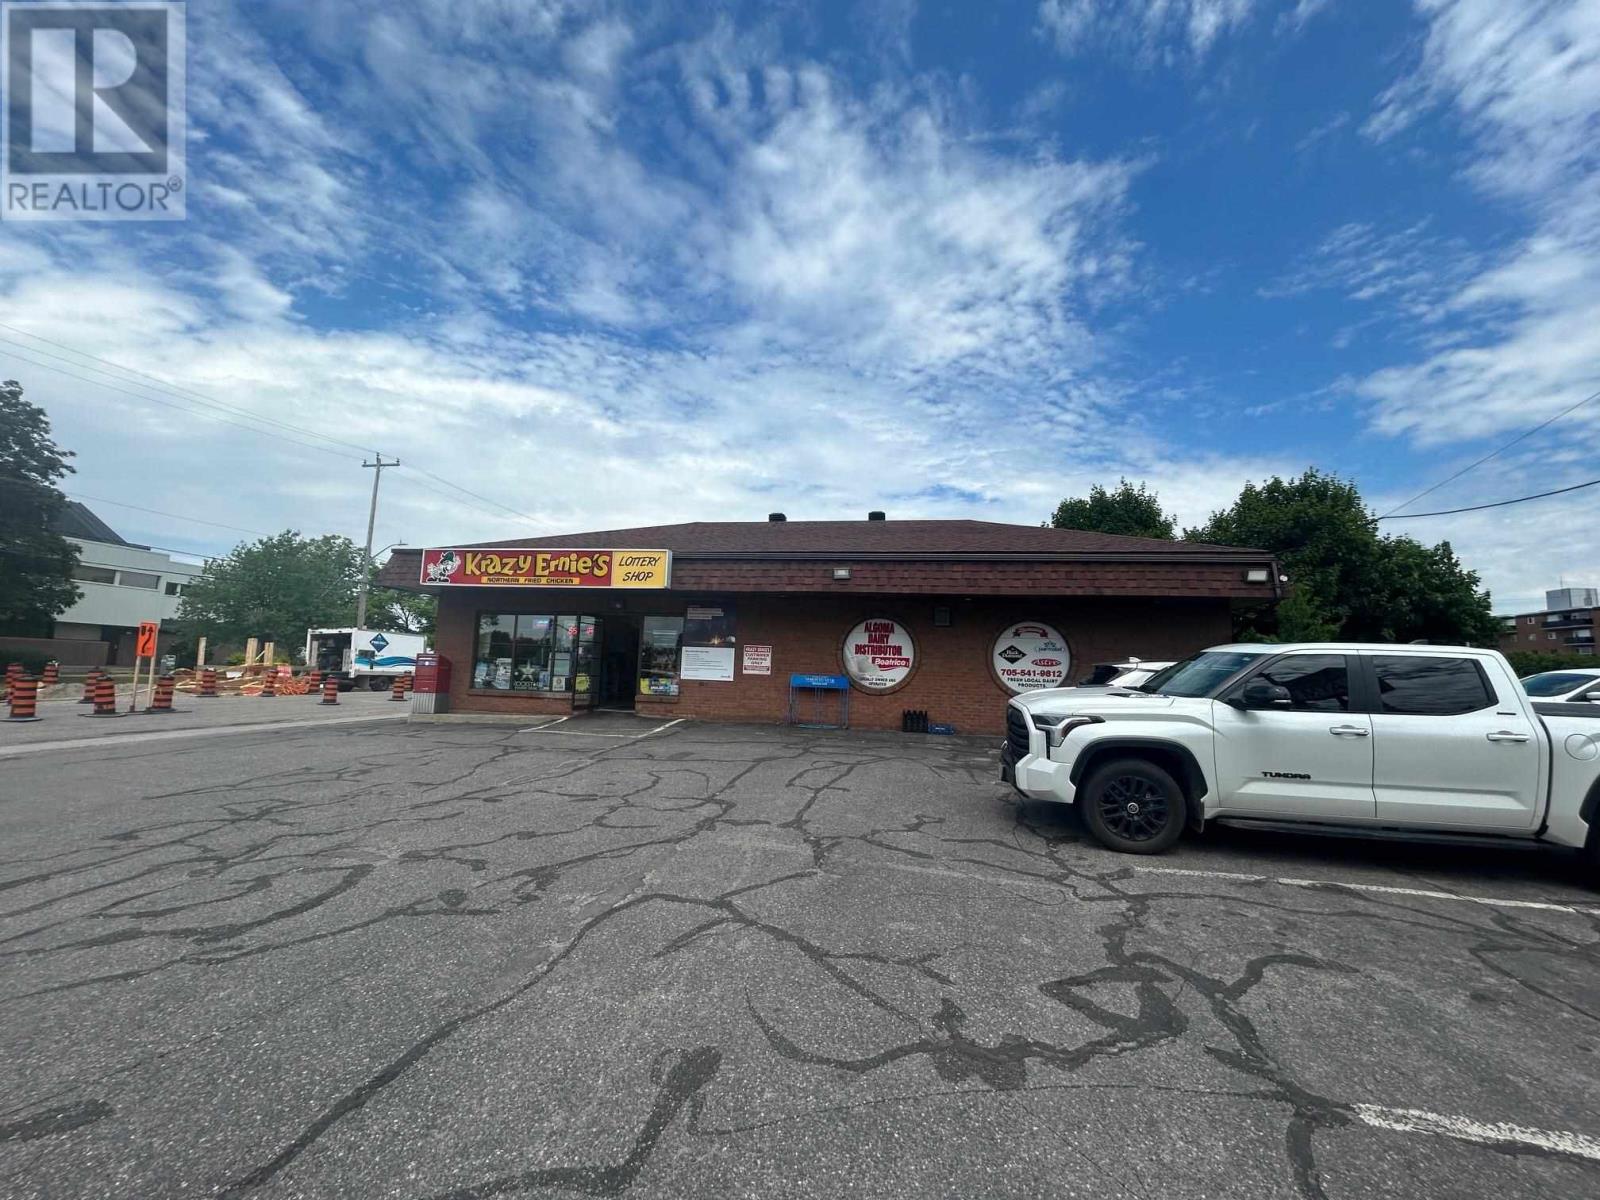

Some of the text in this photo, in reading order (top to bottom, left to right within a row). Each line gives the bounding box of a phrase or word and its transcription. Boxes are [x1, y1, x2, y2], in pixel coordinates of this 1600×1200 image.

[619, 556, 660, 567] LOTTERY
[623, 571, 654, 582] SHOP
[864, 622, 894, 633] ALGOMA
[868, 633, 889, 644] DAIRY
[855, 644, 902, 656] DISTRIBUTOR
[1001, 668, 1062, 678] 705-541-9812
[1261, 771, 1311, 780] TUNDRA
